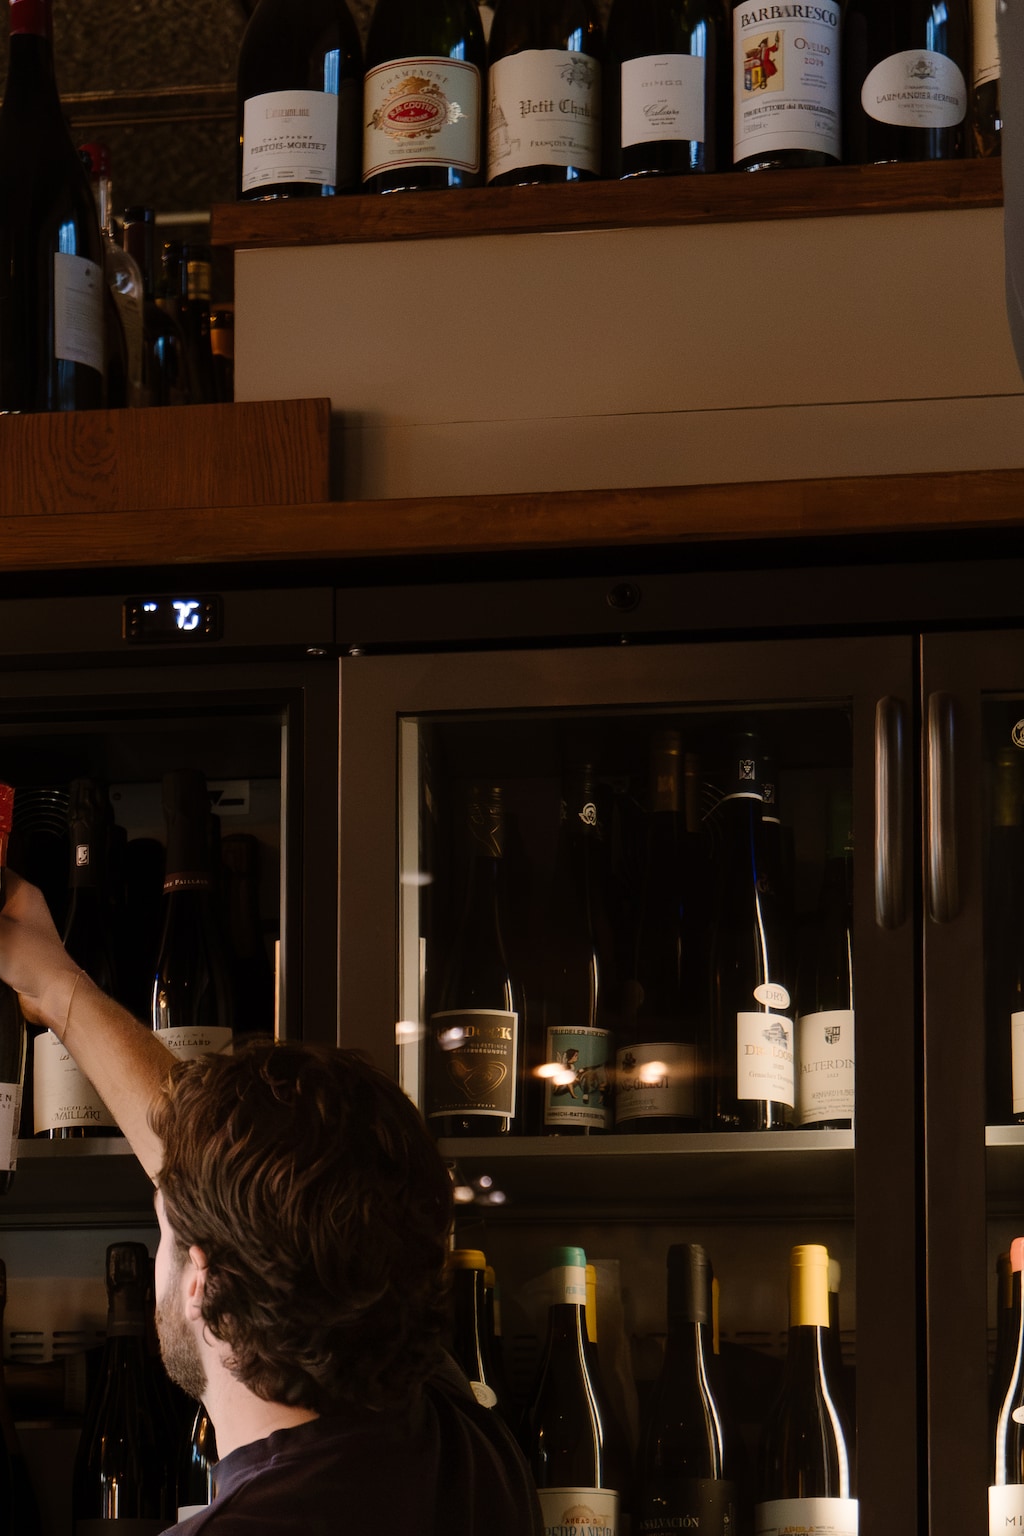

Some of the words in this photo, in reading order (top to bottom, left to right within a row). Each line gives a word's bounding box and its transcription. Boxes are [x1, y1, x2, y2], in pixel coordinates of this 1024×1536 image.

[741, 4, 838, 28] BARBARESCO
[380, 70, 449, 91] CHAMPAGNE
[519, 99, 555, 118] Petit
[766, 991, 784, 1002] DRY
[168, 1040, 212, 1048] PAILLARD
